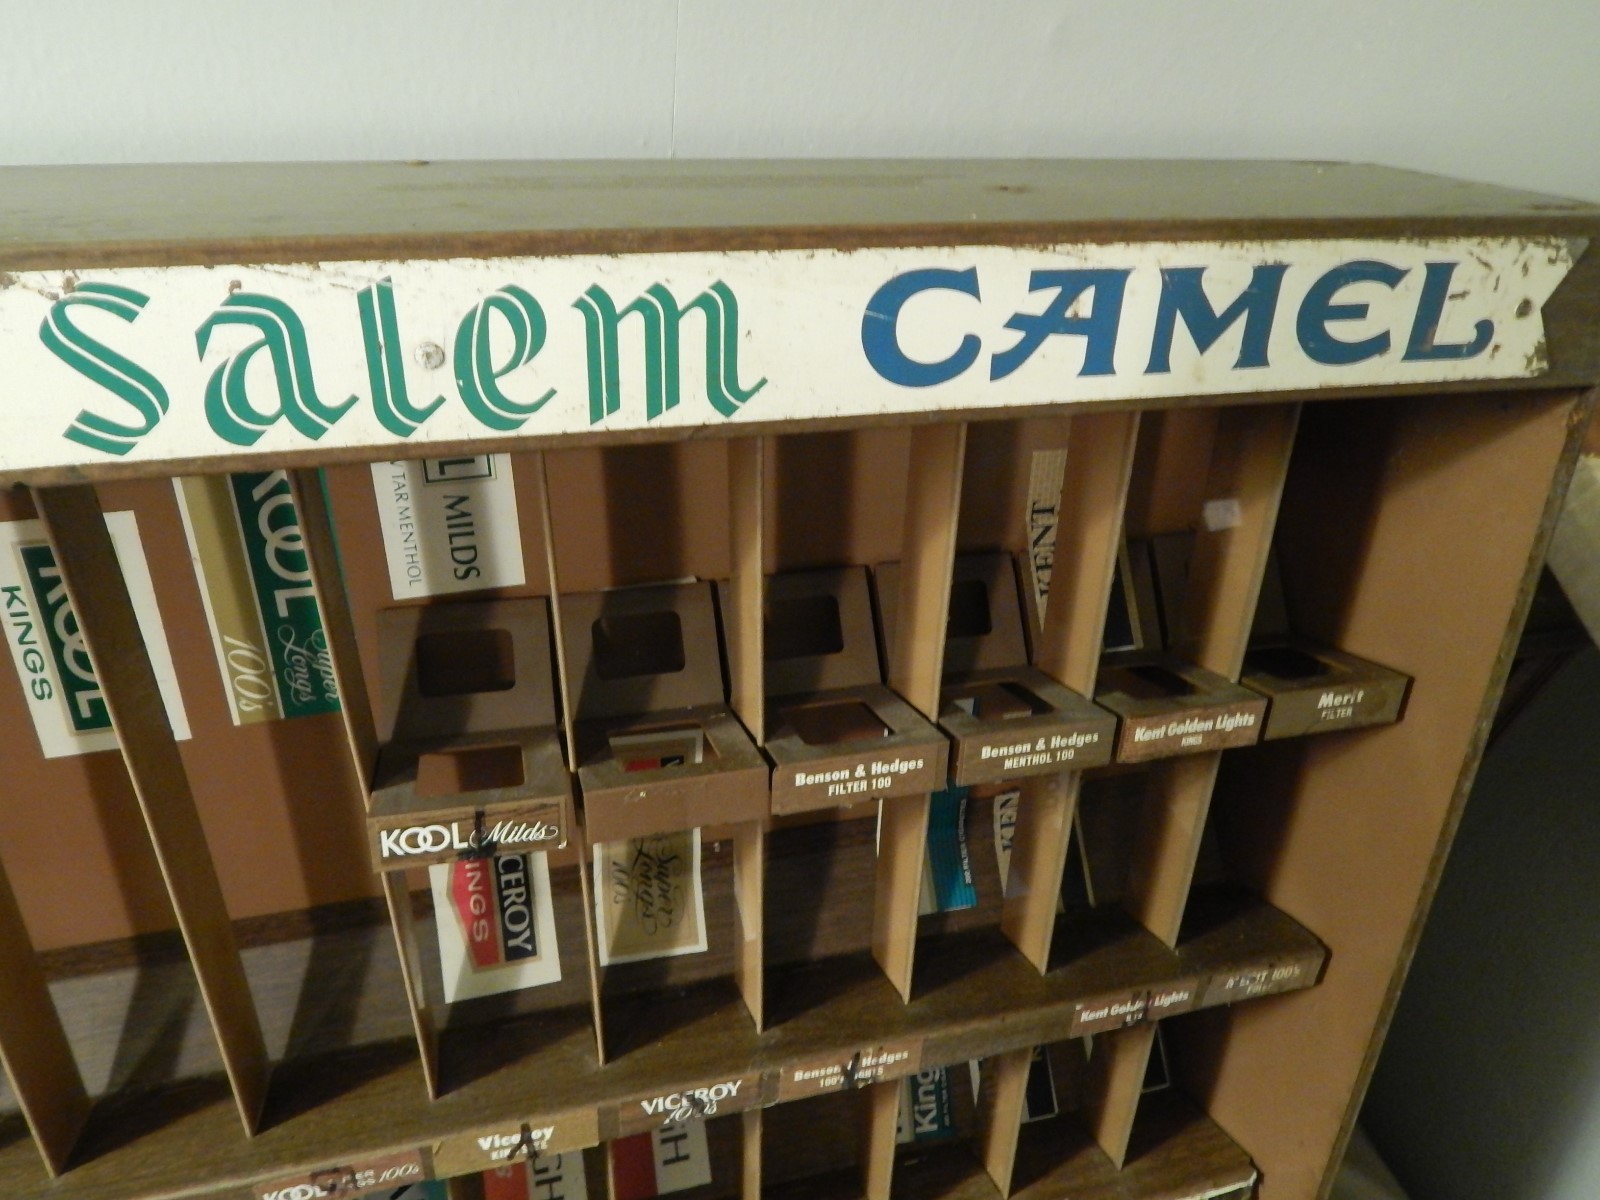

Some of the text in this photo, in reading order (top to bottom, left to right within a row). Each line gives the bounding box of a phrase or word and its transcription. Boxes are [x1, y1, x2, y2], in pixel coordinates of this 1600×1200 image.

[861, 260, 1494, 388] CAMEL
[39, 276, 768, 457] Salem
[391, 472, 409, 503] TAR
[399, 505, 422, 587] MENTHOL
[443, 494, 480, 581] MILDS
[1, 585, 52, 701] KINGS
[1317, 689, 1365, 709] Merit
[1134, 712, 1255, 742] Kent Golden Lights
[981, 732, 1099, 759] Benson & Hedges
[1004, 748, 1075, 770] MENTHOL 100
[795, 758, 924, 787] Benson & Hedges
[828, 776, 892, 796] FILTER 100
[380, 820, 559, 857] KOOL Milds
[464, 857, 489, 943] INGS
[1080, 1007, 1109, 1022] Kent
[1110, 999, 1153, 1016] Golde
[1154, 991, 1190, 1007] Lights
[794, 1064, 841, 1081] Benson
[861, 1051, 909, 1068] Hedges
[640, 1080, 743, 1115] VICEROY
[478, 1126, 555, 1151] Viceoy
[490, 1145, 520, 1161] KIN
